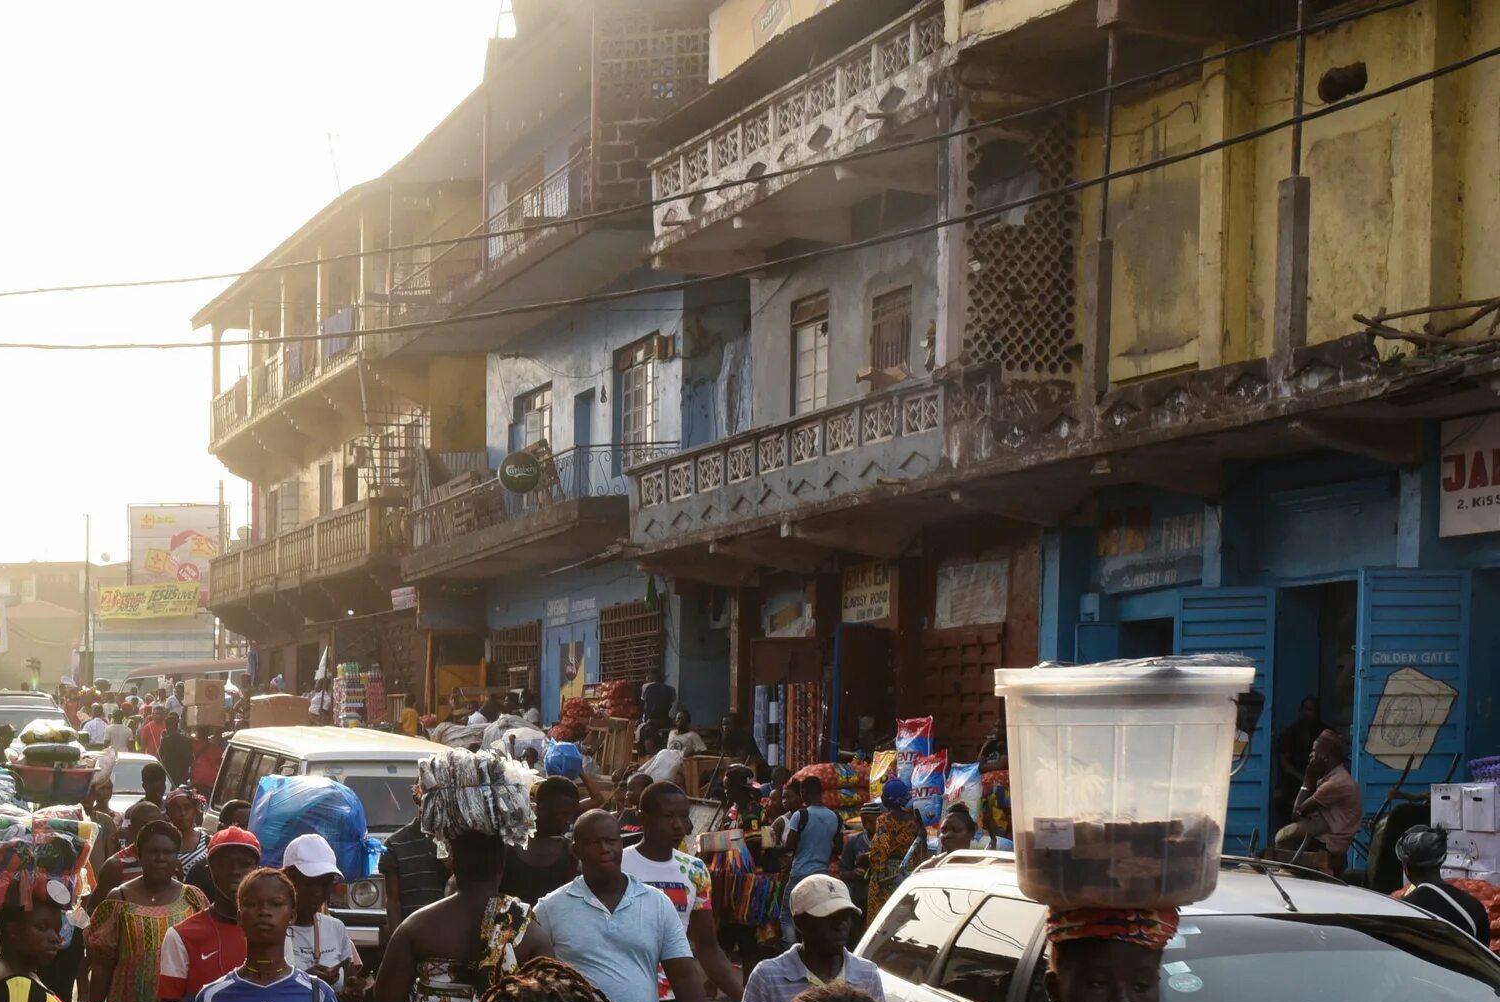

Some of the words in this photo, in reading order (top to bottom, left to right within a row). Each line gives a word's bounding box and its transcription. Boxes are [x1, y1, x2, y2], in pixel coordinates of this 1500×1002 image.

[147, 588, 179, 604] JESUS
[1372, 651, 1417, 664] GOLDEN
[1421, 651, 1453, 664] GATE
